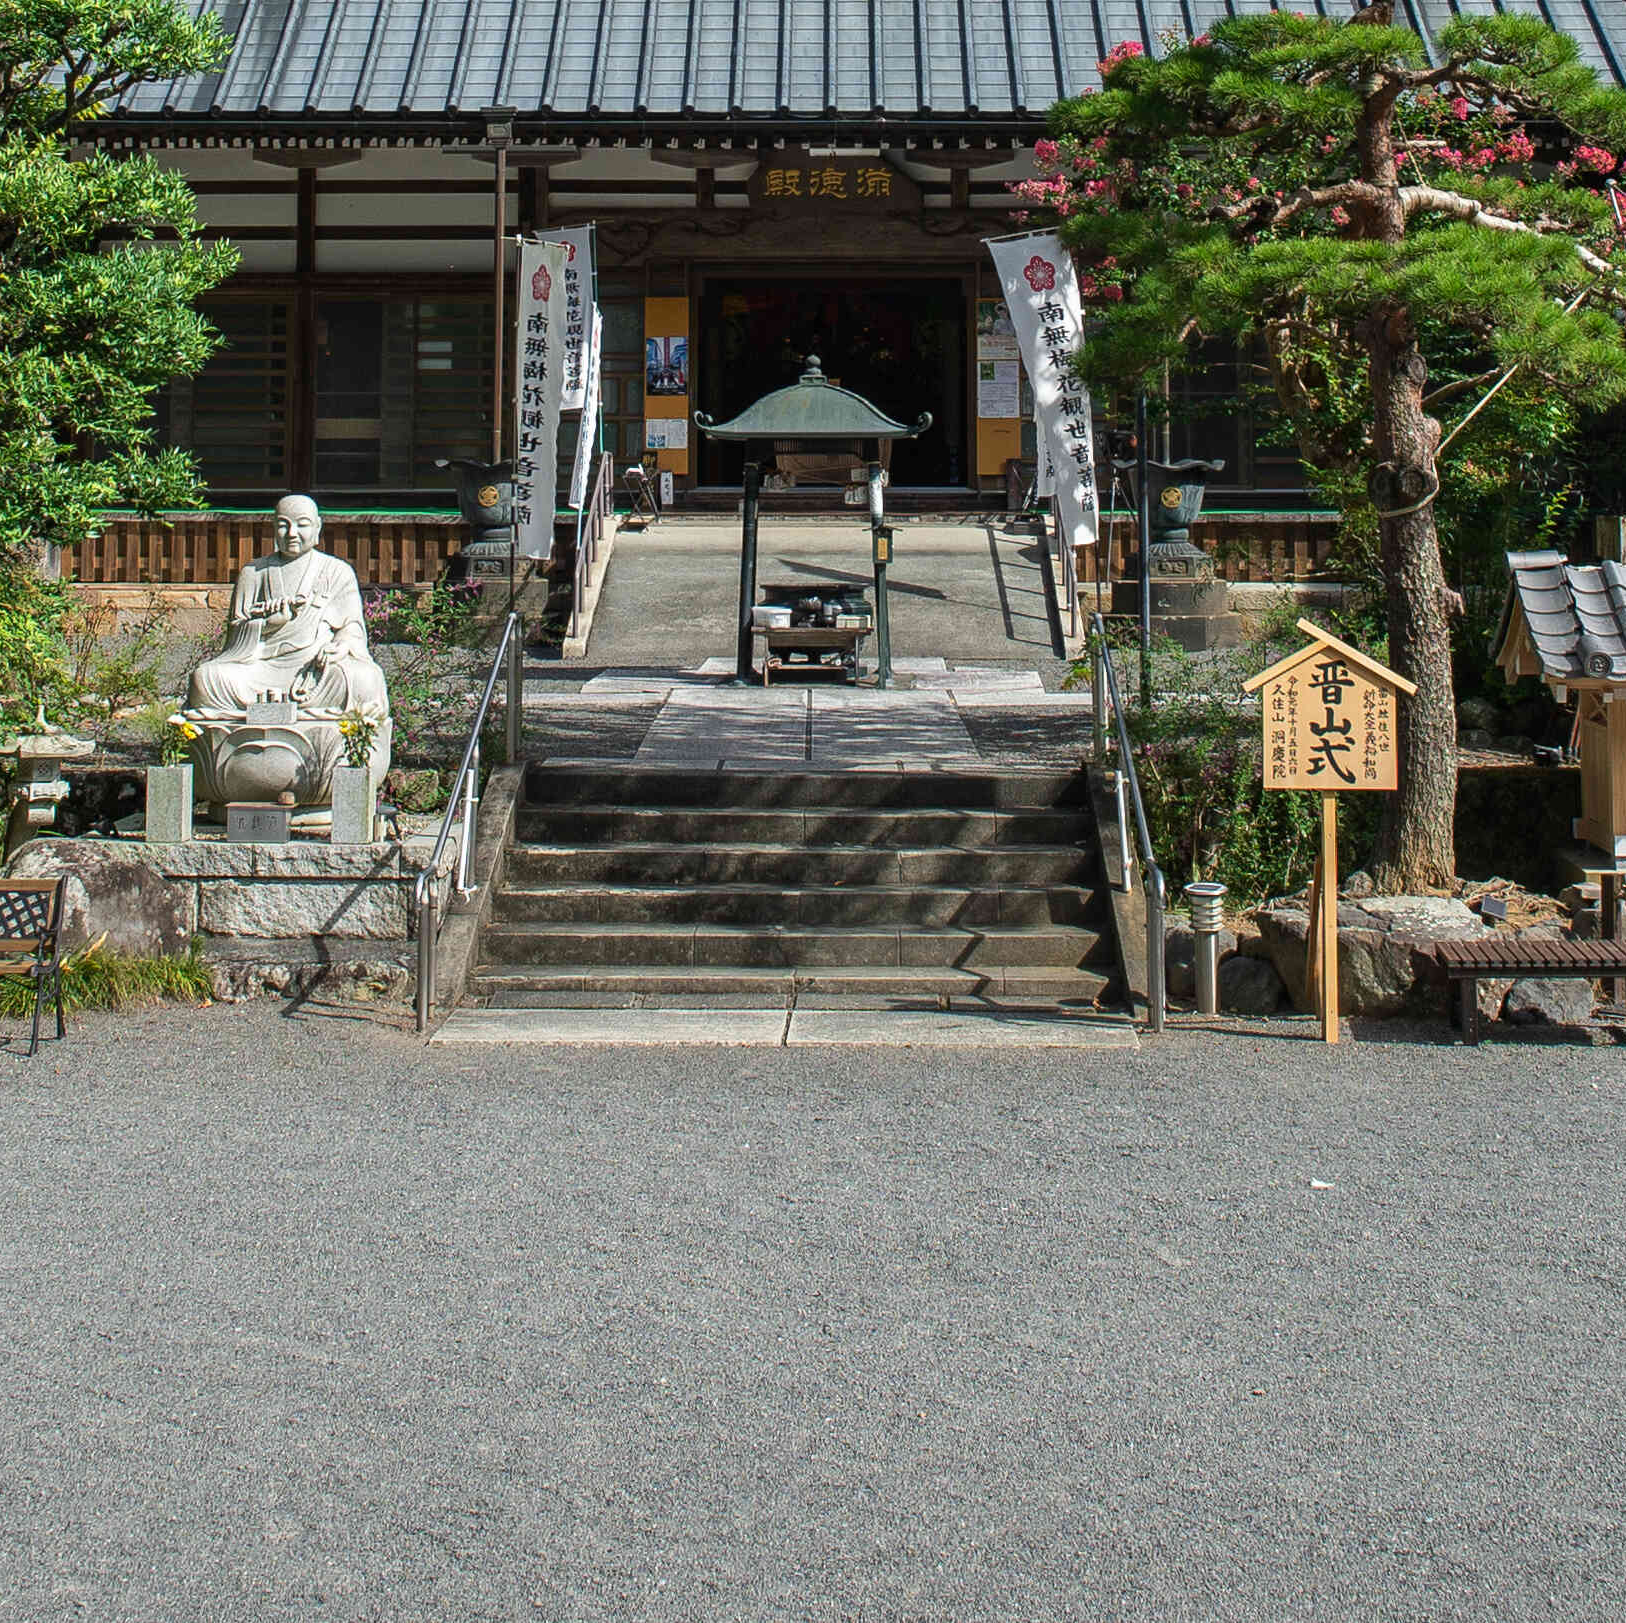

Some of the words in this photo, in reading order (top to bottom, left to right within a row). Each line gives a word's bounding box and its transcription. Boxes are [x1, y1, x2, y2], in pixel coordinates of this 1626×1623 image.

[1272, 683, 1286, 723] 久住山
[1306, 659, 1356, 784] 晋山式
[1271, 729, 1286, 780] 洞慶院
